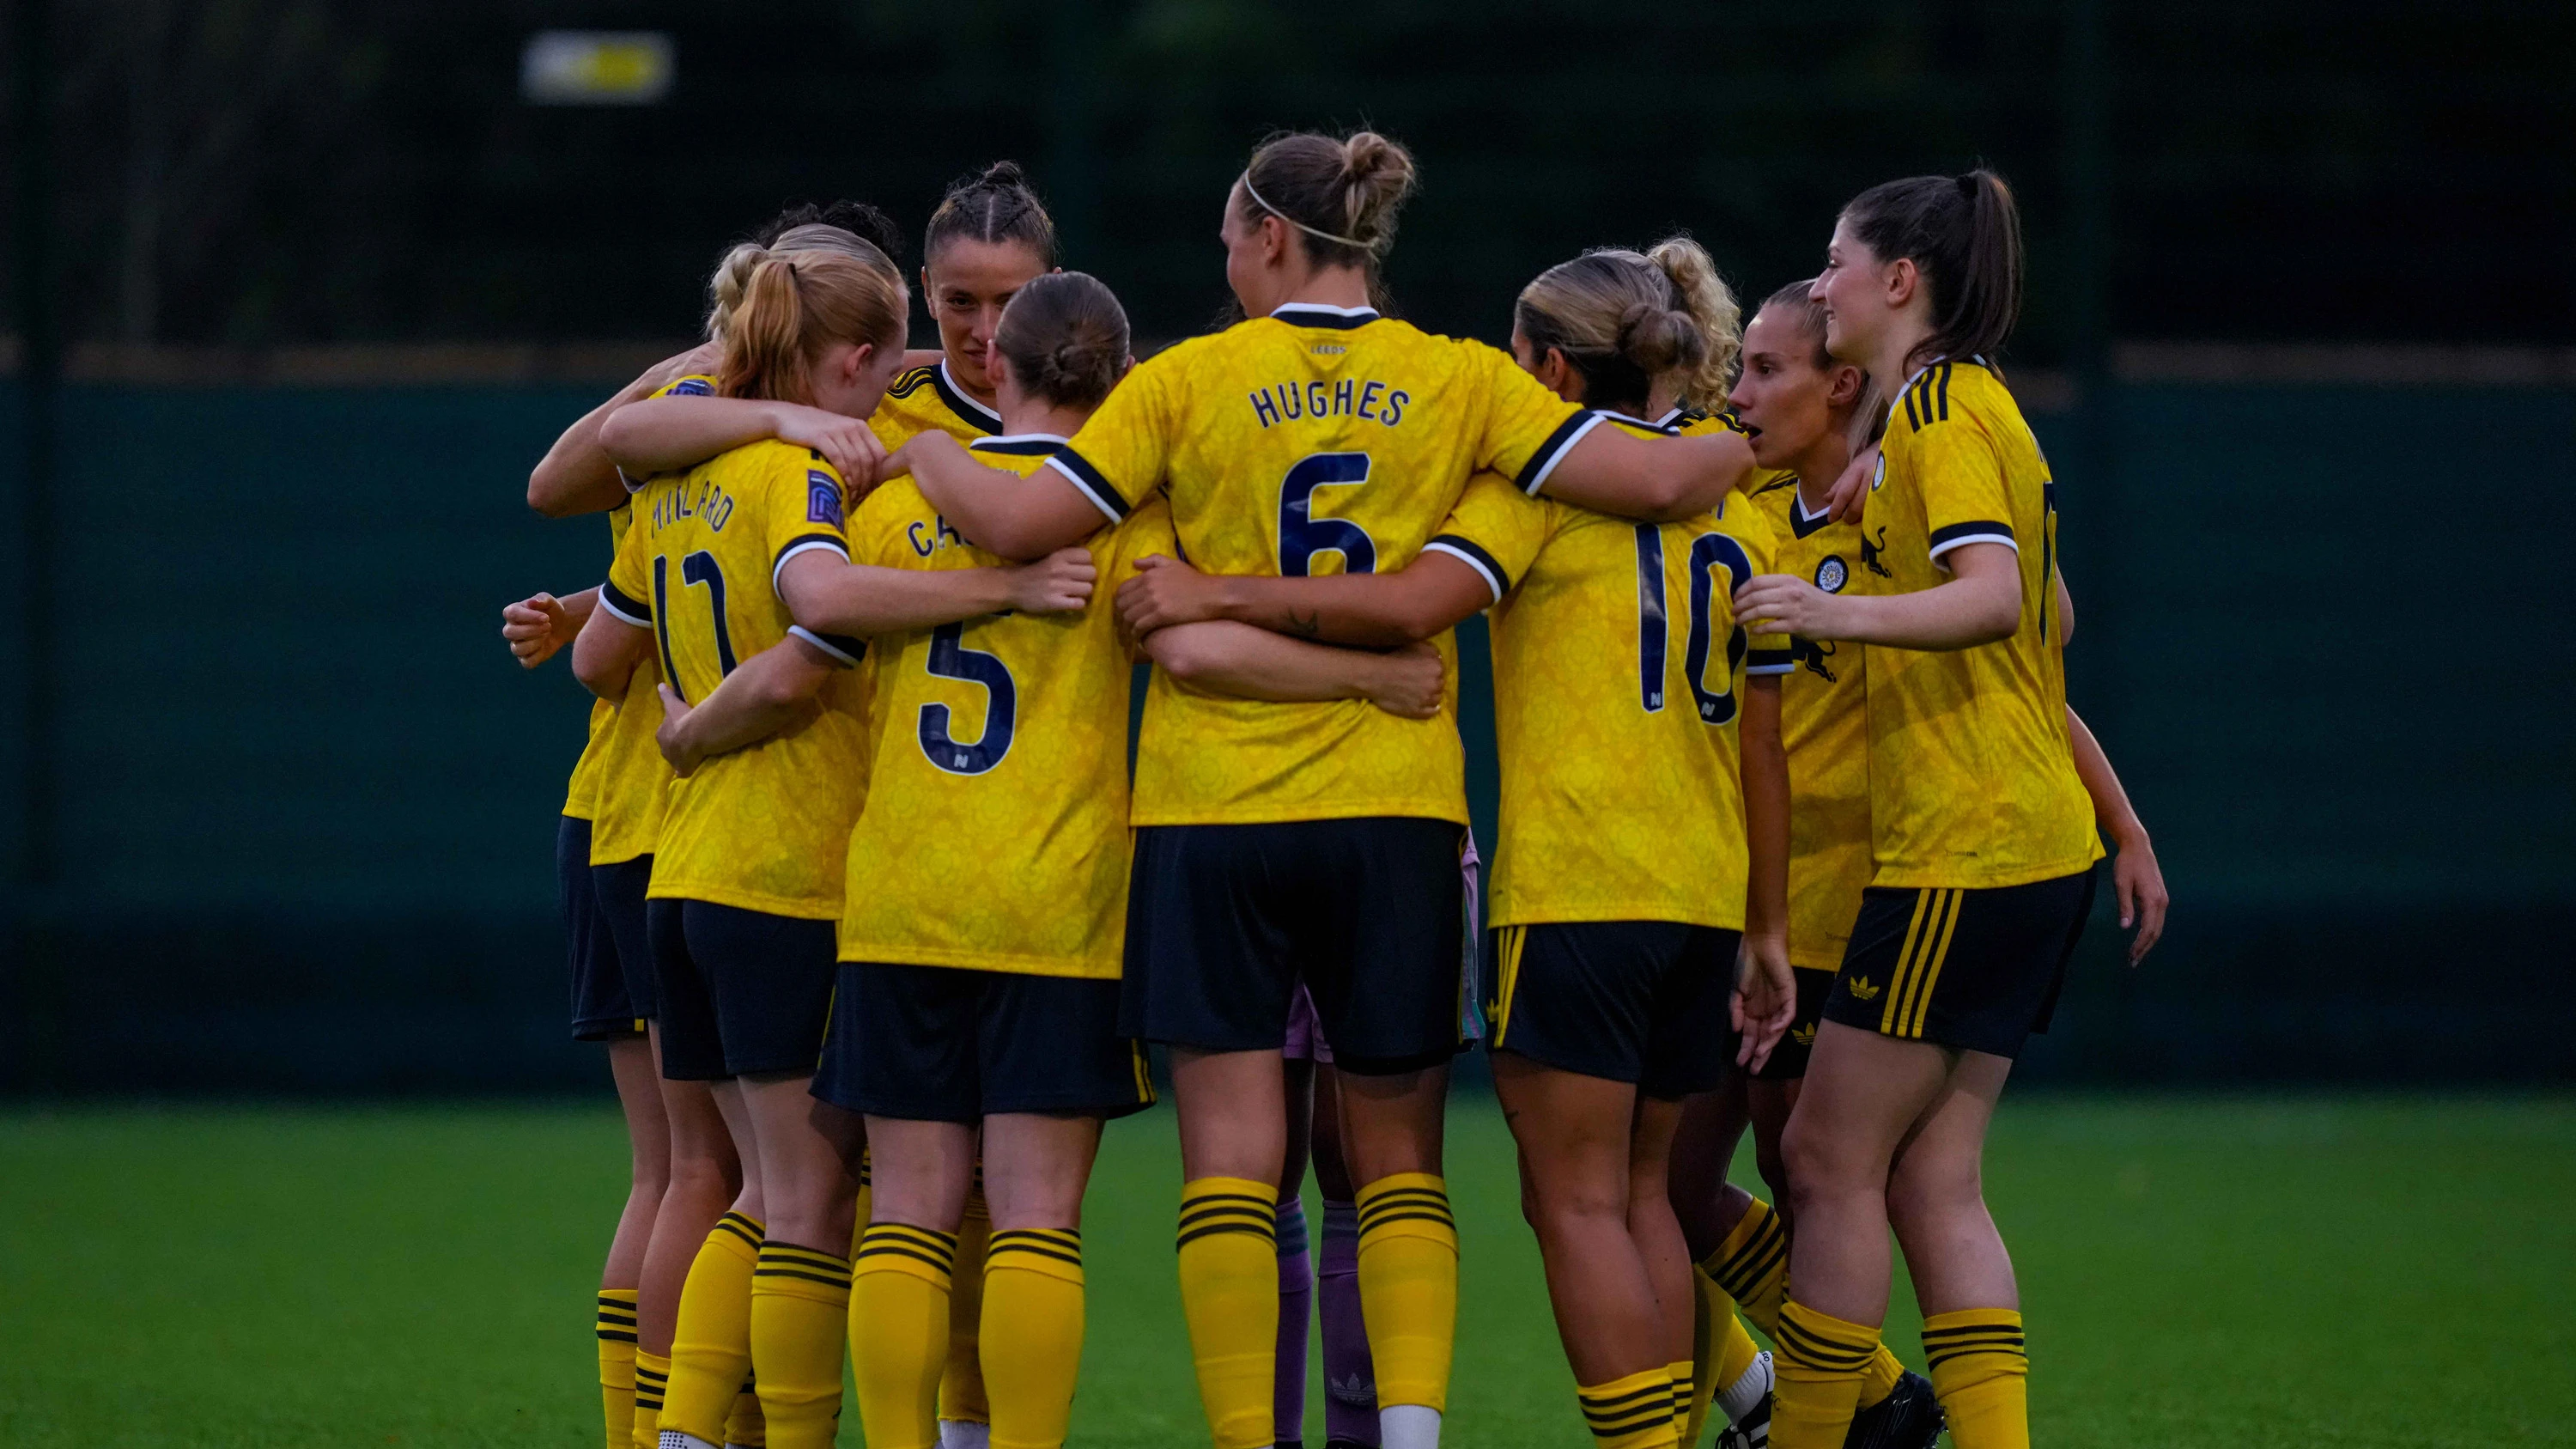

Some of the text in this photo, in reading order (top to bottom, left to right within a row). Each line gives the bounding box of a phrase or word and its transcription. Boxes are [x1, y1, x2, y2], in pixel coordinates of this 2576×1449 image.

[1310, 345, 1346, 354] LEEDS
[1249, 378, 1410, 429] HUGHES
[651, 479, 734, 539] MILLARD
[1278, 451, 1377, 576] 6
[1634, 522, 1753, 726] 10
[917, 610, 1017, 776] 5
